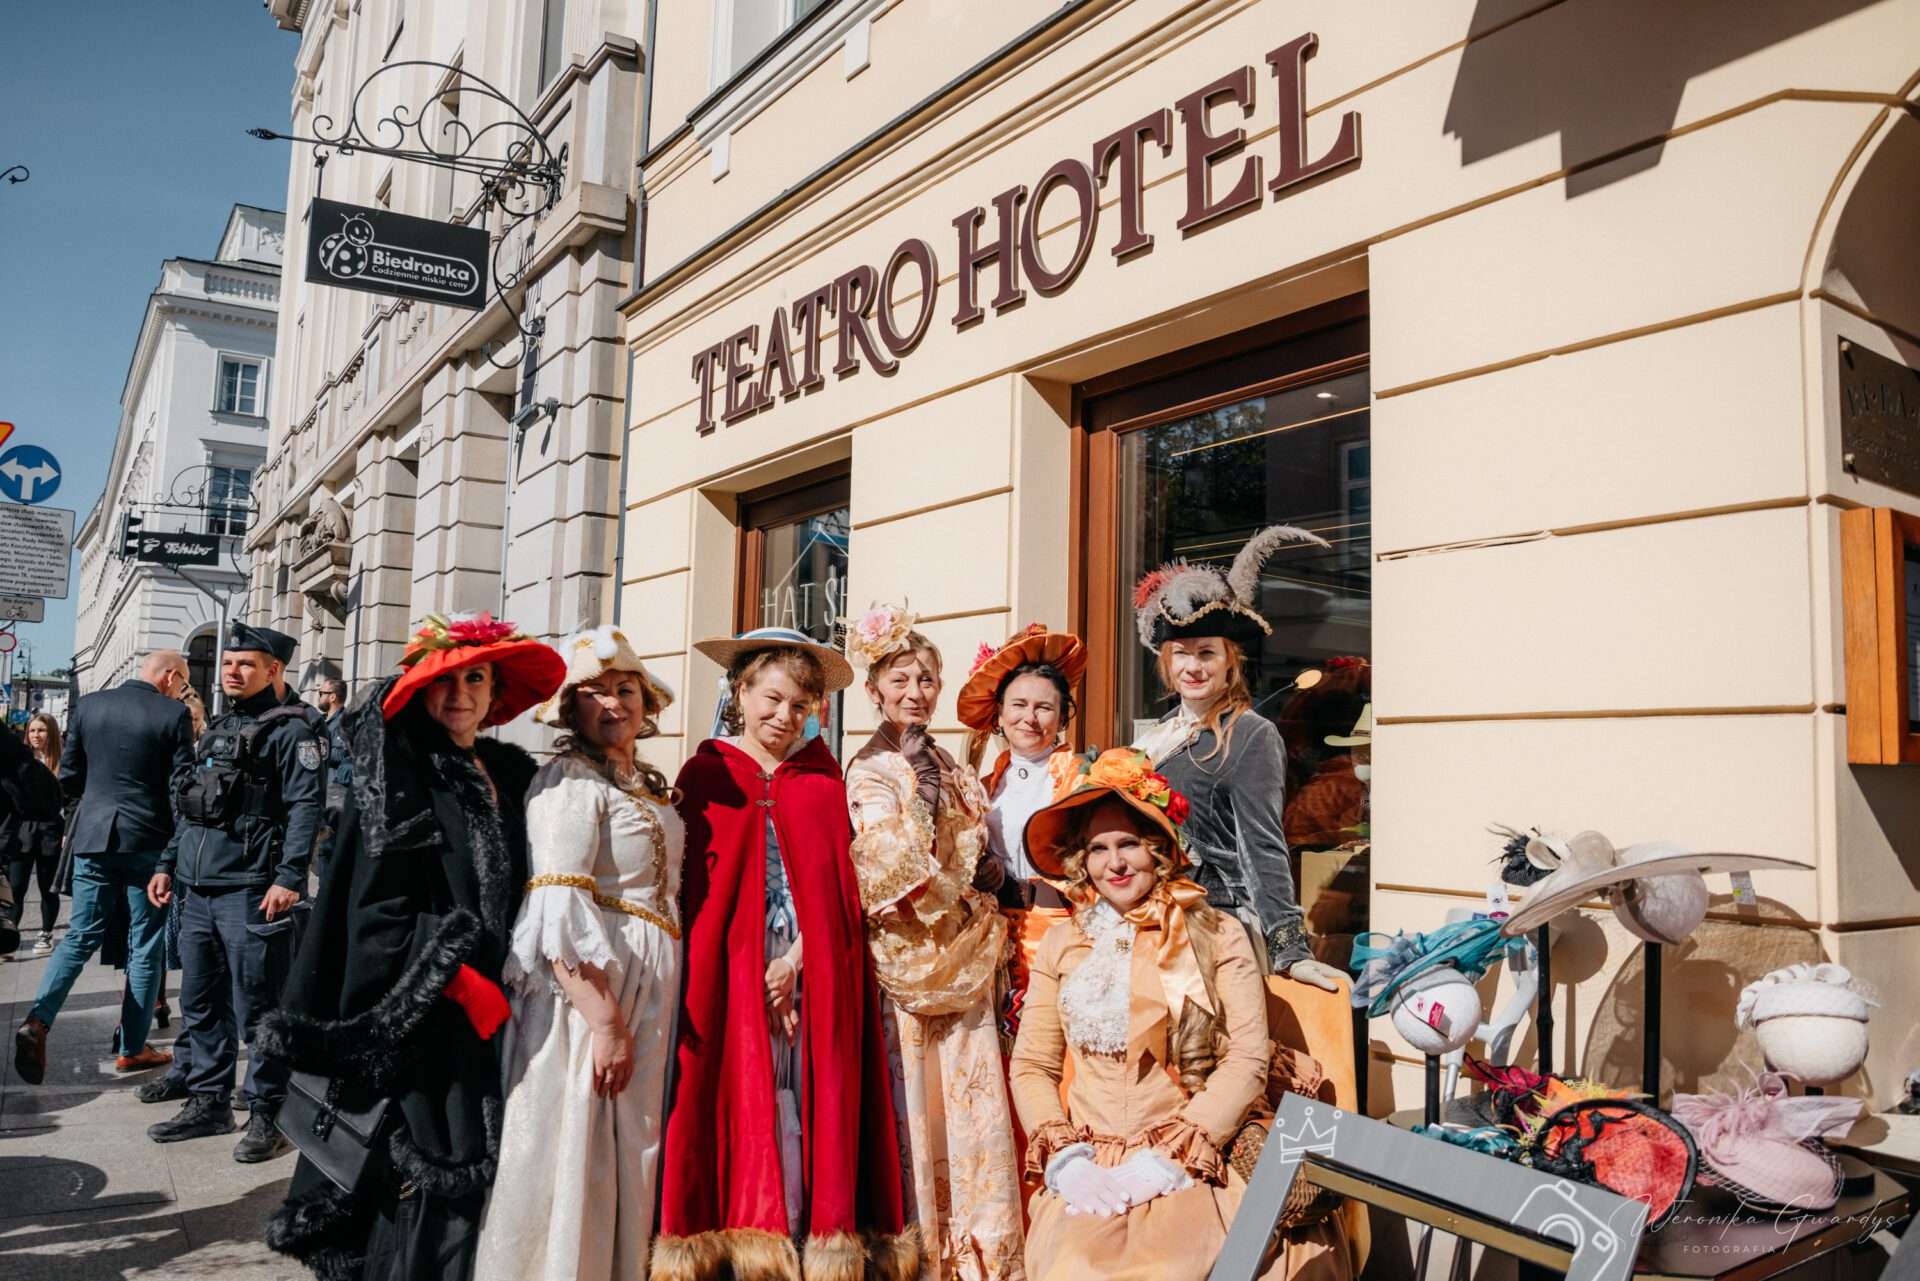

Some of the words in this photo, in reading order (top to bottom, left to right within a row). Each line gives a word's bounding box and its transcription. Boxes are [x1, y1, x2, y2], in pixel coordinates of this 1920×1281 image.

[691, 238, 938, 433] TEATRO
[951, 31, 1363, 327] HOTEL
[371, 264, 420, 281] Codziennie
[421, 275, 447, 286] niskie
[448, 280, 469, 290] ceny
[372, 249, 470, 282] Biedronka
[164, 541, 215, 556] Tchibo
[761, 582, 817, 632] HAT
